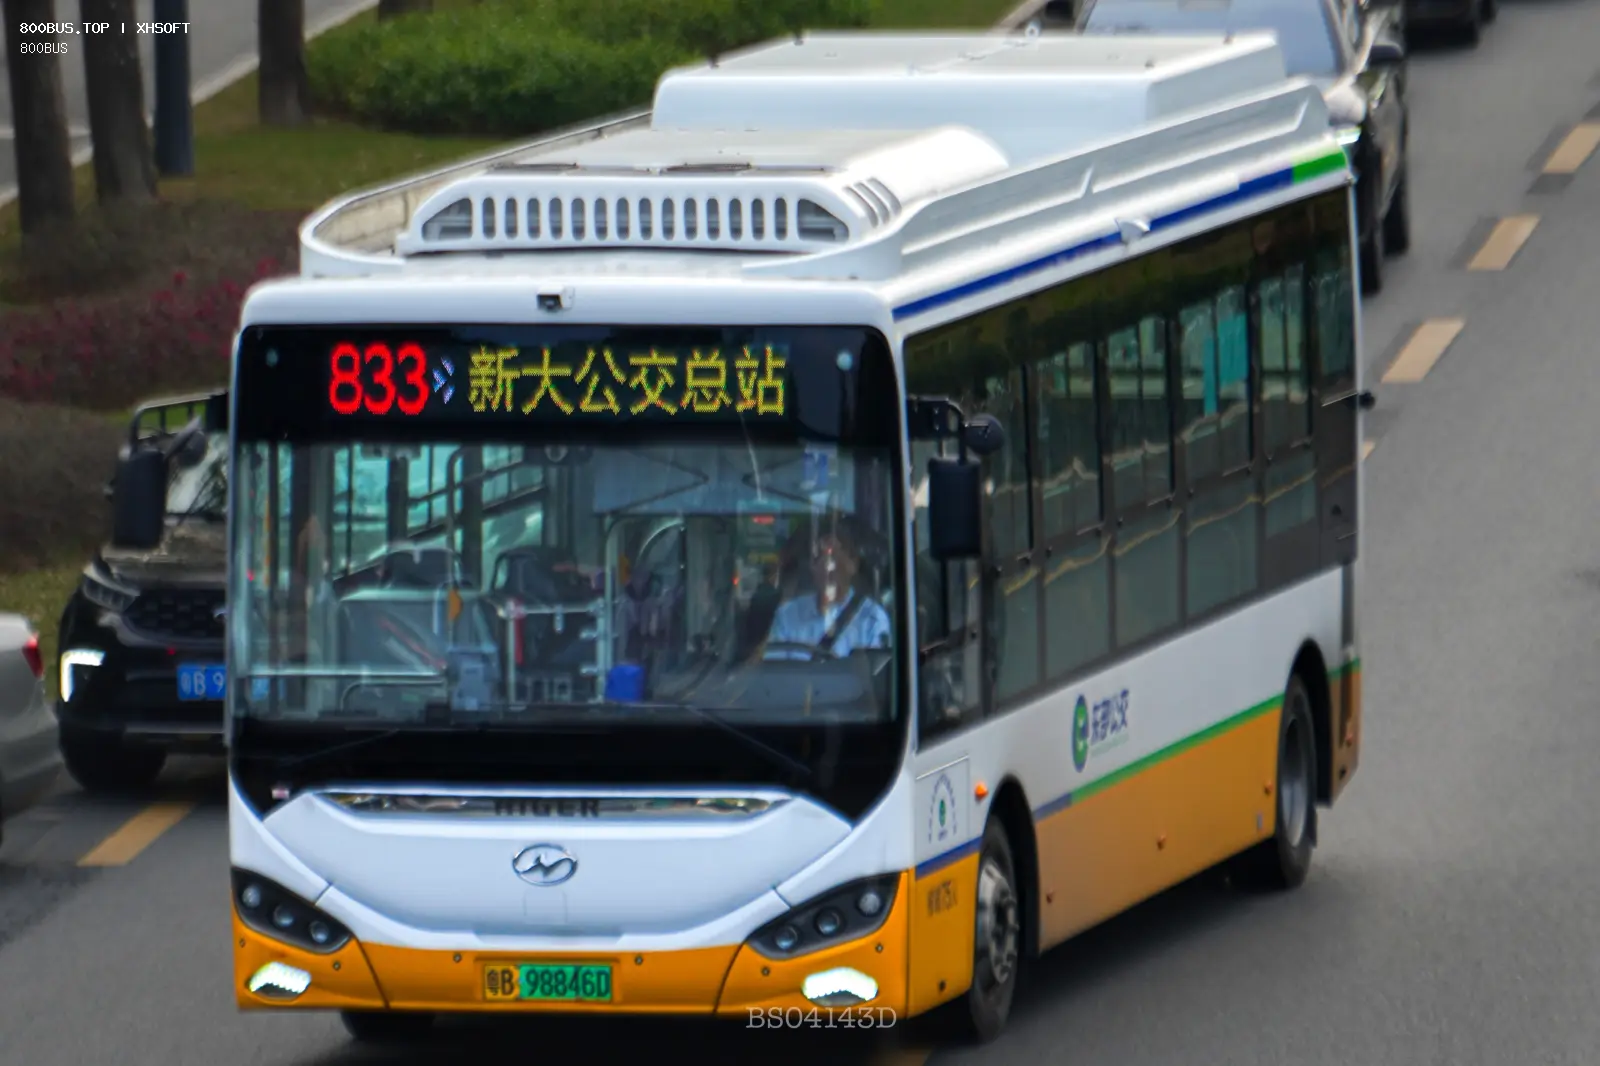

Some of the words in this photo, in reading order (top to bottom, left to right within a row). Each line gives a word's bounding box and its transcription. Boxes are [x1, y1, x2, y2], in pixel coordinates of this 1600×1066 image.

[329, 343, 430, 415] 833
[468, 344, 787, 416] 新大公交总站
